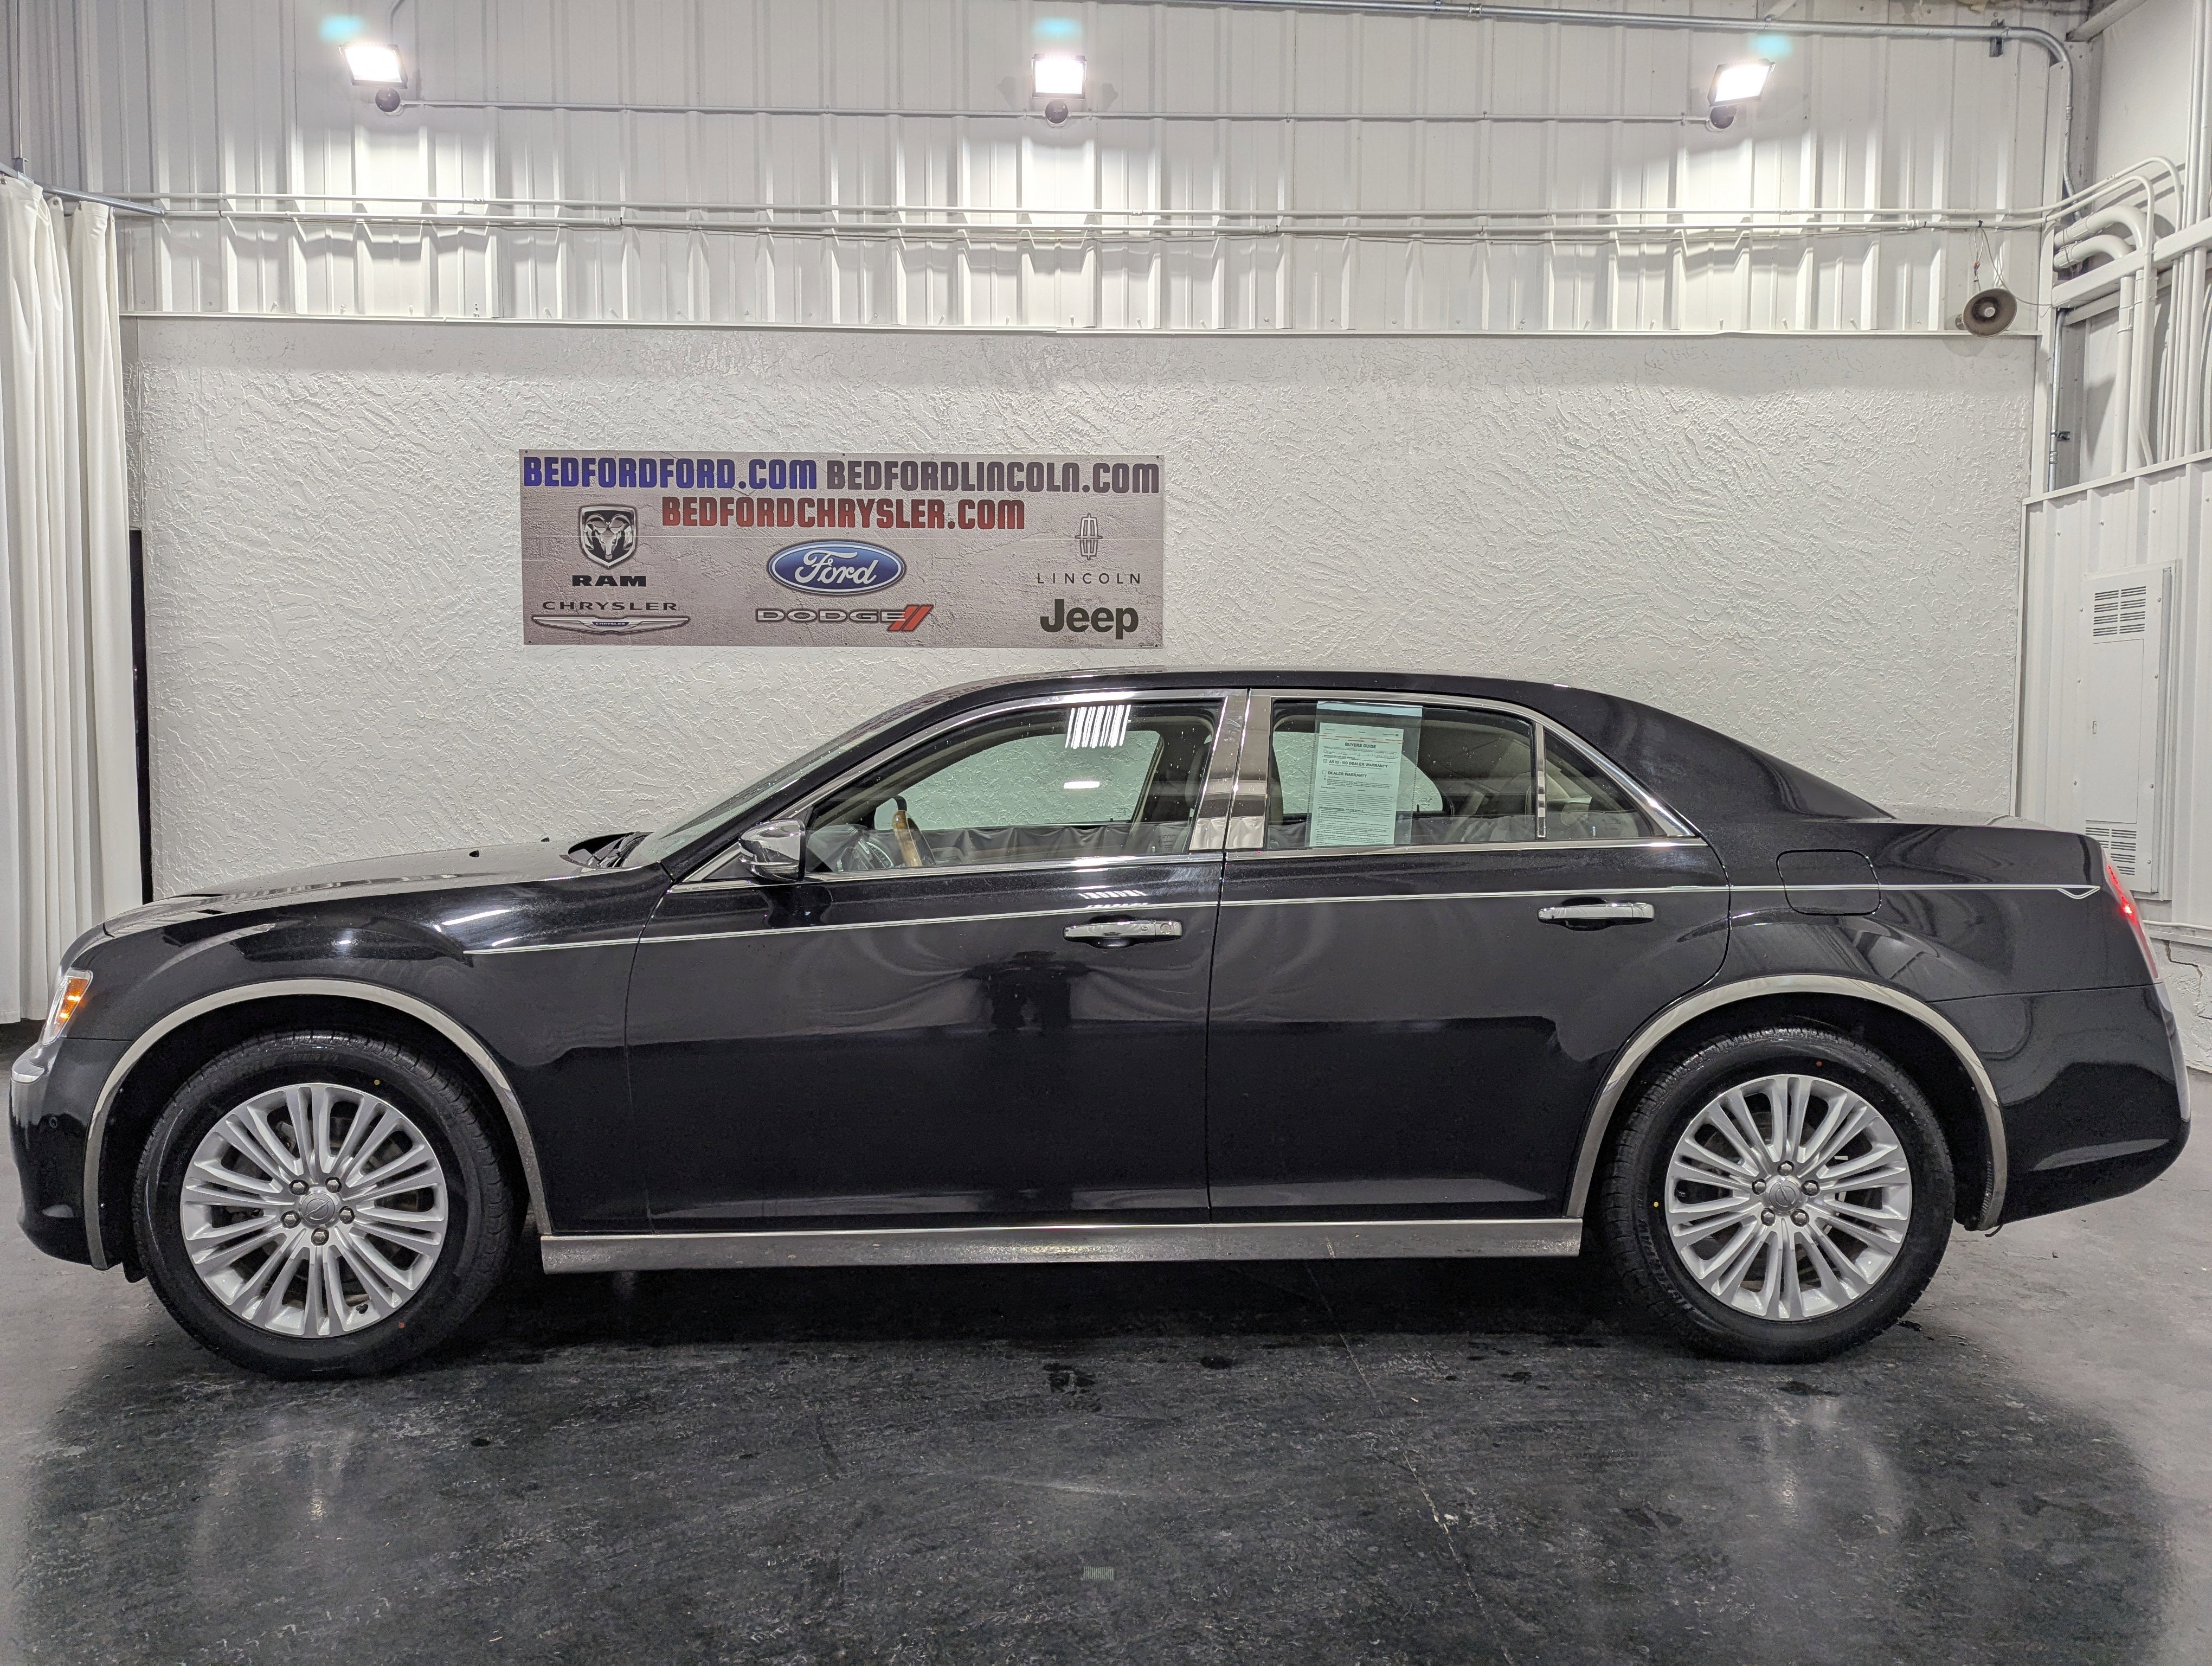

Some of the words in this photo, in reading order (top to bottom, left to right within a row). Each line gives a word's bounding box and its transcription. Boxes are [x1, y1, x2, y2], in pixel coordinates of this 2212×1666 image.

[523, 457, 817, 490] BEDFORDFORD.COM
[827, 460, 1159, 494] BEDFORDLINCOLN.COM
[662, 496, 1025, 530] BEDFORDCHRYSLER.COM
[794, 549, 879, 585] Ford
[1037, 573, 1140, 584] LINCOLN
[572, 575, 647, 587] RAM
[542, 601, 678, 611] CHRYSLER
[757, 610, 906, 622] DODGE
[1040, 598, 1139, 640] Jeep
